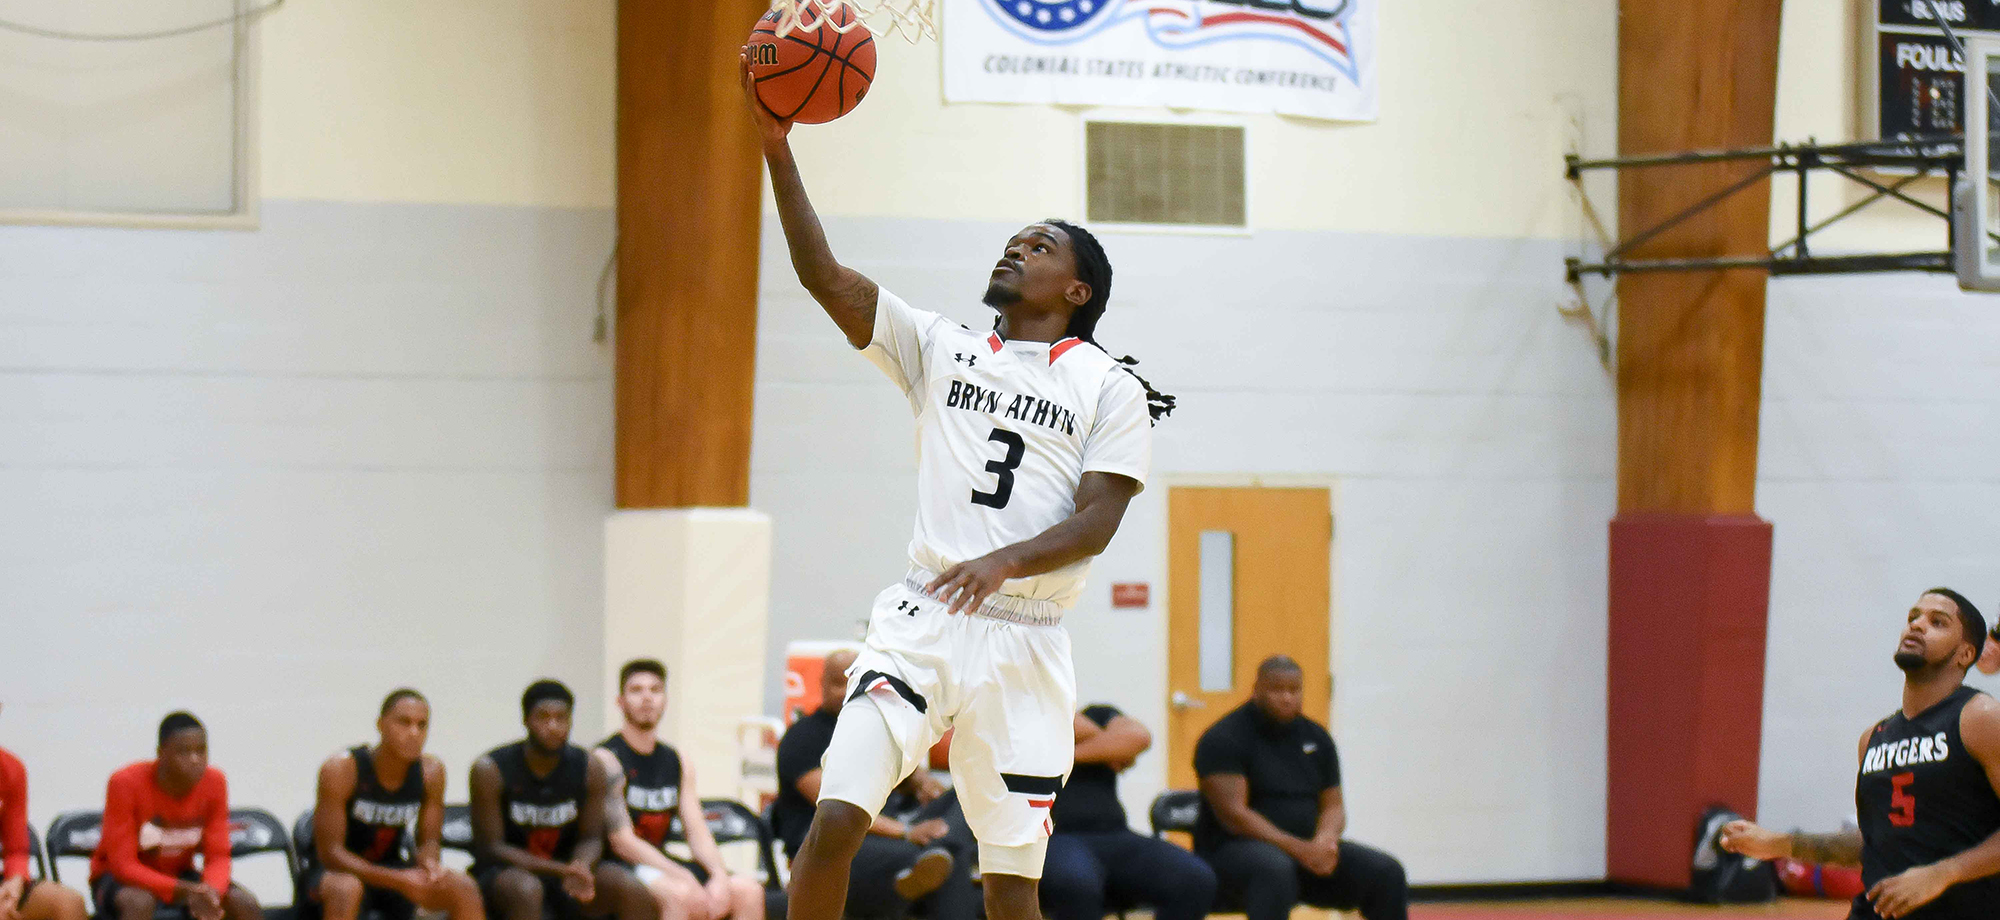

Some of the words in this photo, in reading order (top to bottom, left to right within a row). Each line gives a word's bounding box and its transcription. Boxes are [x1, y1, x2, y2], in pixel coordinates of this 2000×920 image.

[983, 54, 1079, 75] COLONIAL
[1086, 58, 1143, 79] STATES
[1152, 62, 1232, 84] ATHLETIC
[1234, 68, 1336, 93] CONFERENCE
[1896, 42, 1967, 72] FOULS
[947, 380, 1003, 414] BRYN
[1004, 394, 1076, 436] ATHYN
[971, 428, 1026, 510] 3
[1862, 731, 1949, 775] RUTGERS
[1887, 771, 1916, 828] 5
